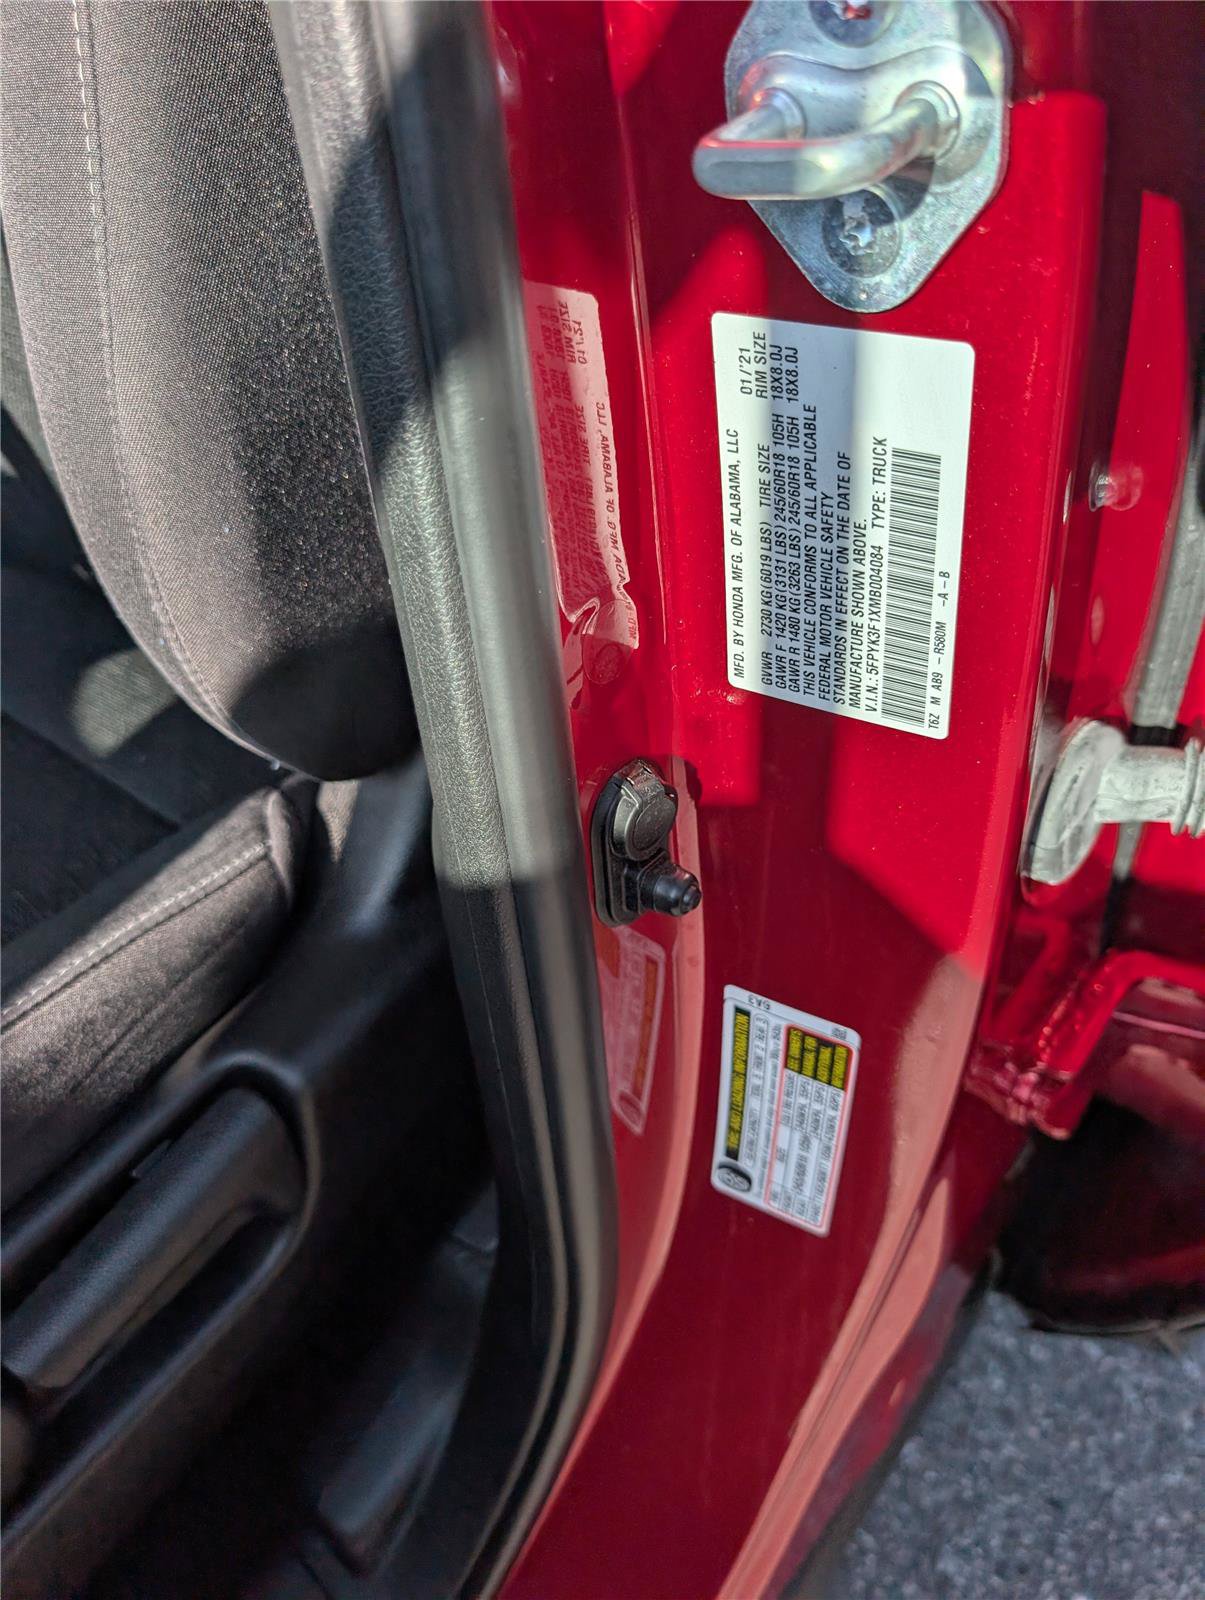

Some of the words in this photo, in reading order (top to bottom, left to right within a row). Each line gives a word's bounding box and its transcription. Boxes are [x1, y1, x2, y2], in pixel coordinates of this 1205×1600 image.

[753, 332, 766, 365] SIZE
[756, 370, 767, 399] RIM
[770, 344, 783, 400] 18X8.0J
[785, 347, 798, 402] 18X8.0J
[726, 428, 738, 454] LLC
[772, 414, 784, 447] 105H
[788, 417, 799, 449] 105H
[758, 444, 770, 473] SIZE
[804, 405, 816, 490] APPLICABLE
[838, 451, 850, 470] OF
[872, 437, 887, 485] TRUCK
[728, 460, 741, 526] ALABAMA,
[759, 478, 770, 507] TIRE
[772, 453, 786, 522] 245/60R18
[788, 456, 800, 525] 245/60R18
[837, 475, 850, 511] DATE
[804, 496, 816, 519] ALL
[821, 492, 833, 543] SAFETY
[871, 490, 885, 529] TYPE:
[730, 530, 742, 546] OF
[805, 524, 816, 539] TO
[837, 515, 849, 540] THE
[853, 519, 866, 566] ABOVE.
[731, 552, 743, 581] MFG.
[837, 546, 849, 564] ON
[804, 545, 816, 614] CONFORMS
[820, 548, 833, 599] VEHICLE
[732, 587, 744, 628] HONDA
[836, 568, 848, 614] EFFECT
[851, 570, 865, 618] SHOWN
[761, 609, 772, 637] 2730
[775, 612, 786, 638] 1420
[820, 604, 832, 647] MOTOR
[835, 619, 847, 632] IN
[866, 545, 883, 675] 5FPYK3F1XMB004084
[733, 630, 744, 646] BY
[789, 616, 800, 642] 1480
[804, 619, 816, 666] VEHICLE
[776, 644, 786, 652] F
[734, 652, 744, 678] MFD.
[761, 651, 772, 685] GVWR
[776, 655, 786, 689] GAWR
[789, 659, 800, 692] GAWR
[819, 652, 831, 701] FEDERAL
[834, 636, 847, 704] STANDARDS
[849, 622, 863, 708] MANUFACTURE
[931, 672, 943, 691] AB9
[804, 670, 816, 696] THIS
[865, 678, 879, 712] V.I.N.:
[930, 696, 940, 706] M
[928, 713, 940, 729] T6Z
